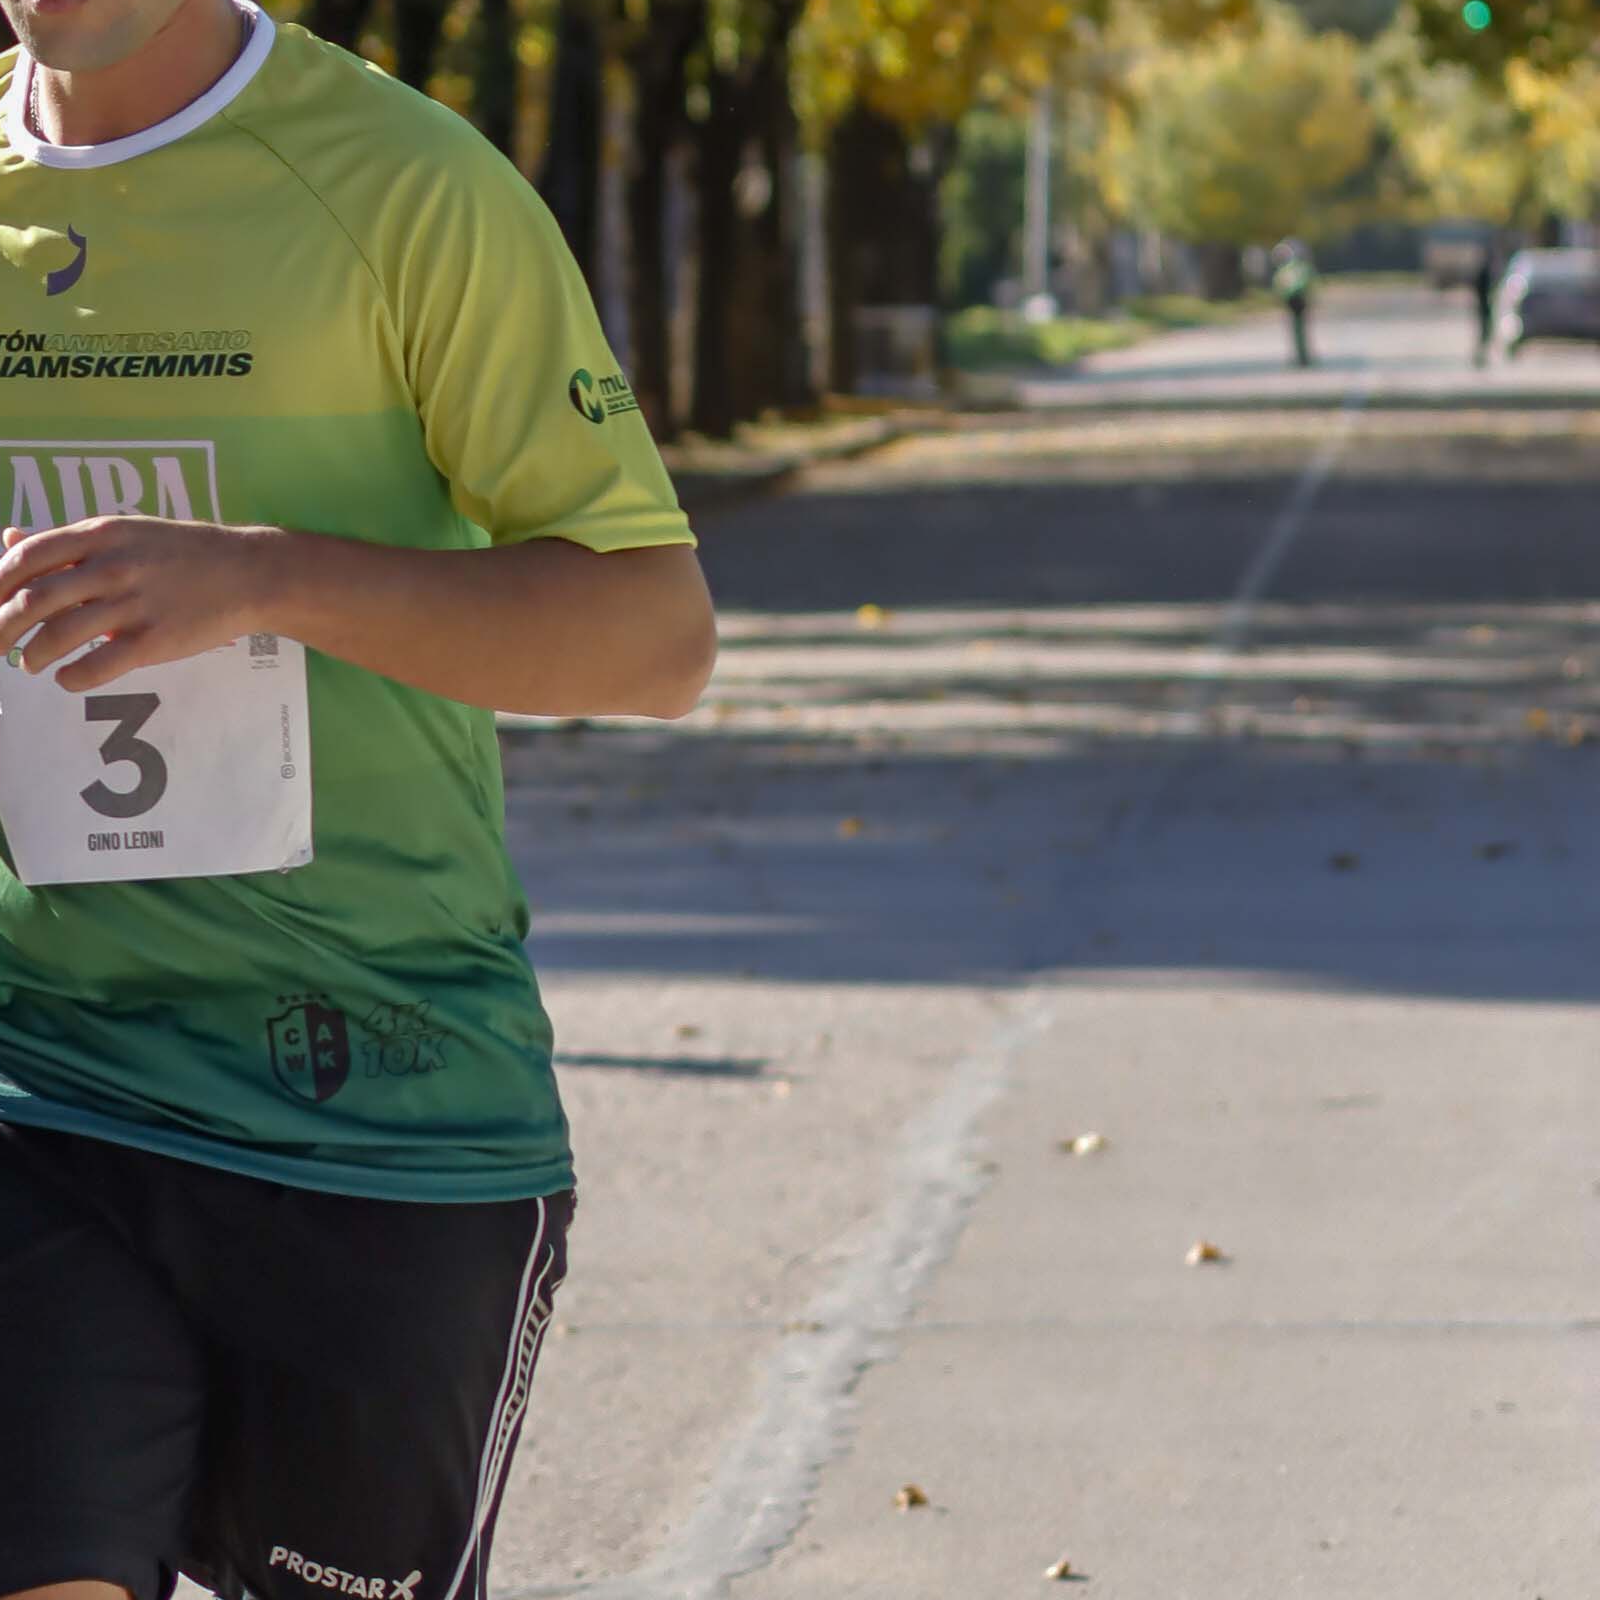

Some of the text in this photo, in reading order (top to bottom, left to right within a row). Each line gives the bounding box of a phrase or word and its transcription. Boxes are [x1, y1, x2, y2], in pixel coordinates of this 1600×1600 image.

[79, 692, 168, 819] 3
[88, 831, 164, 851] GINO LEONI
[284, 1023, 334, 1046] C A
[317, 1051, 338, 1069] K
[363, 1033, 449, 1078] 10K
